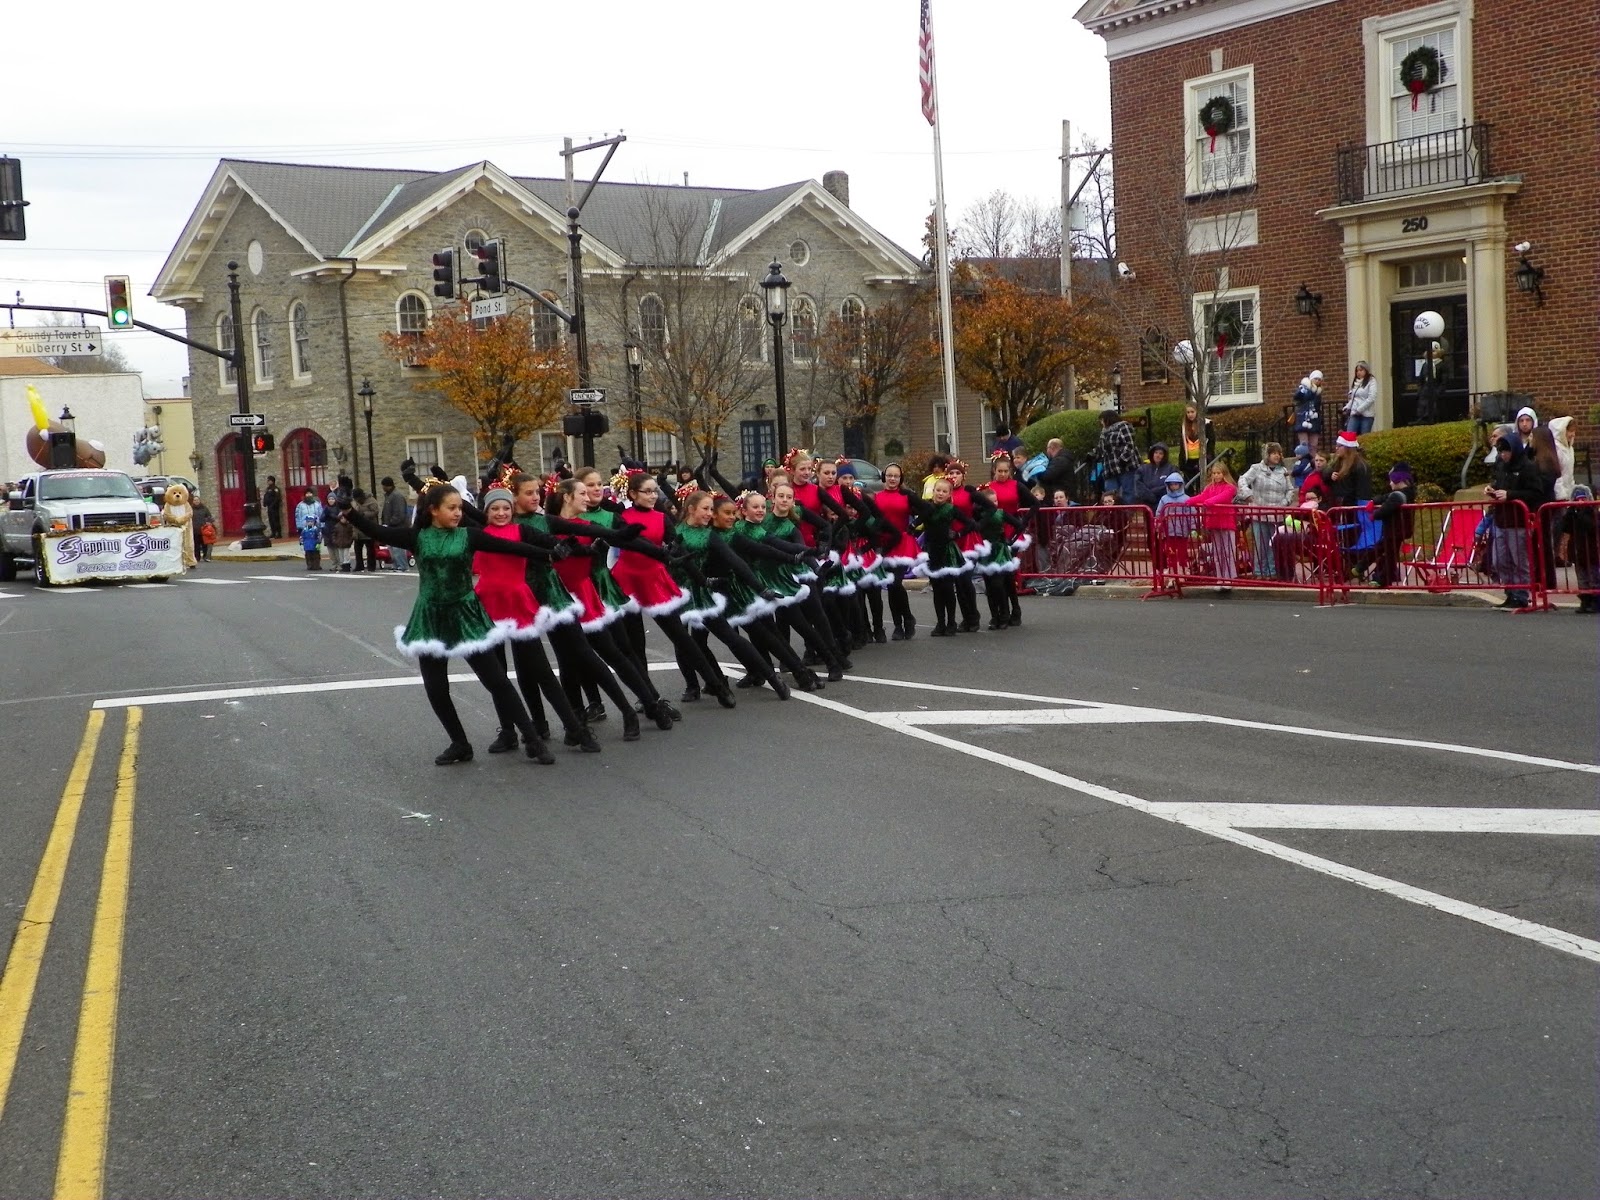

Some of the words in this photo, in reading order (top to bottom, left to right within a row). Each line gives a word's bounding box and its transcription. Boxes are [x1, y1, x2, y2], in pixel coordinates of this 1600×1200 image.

[1402, 216, 1428, 233] 250
[475, 303, 491, 315] Pond
[17, 330, 52, 342] Grundy
[54, 329, 80, 340] Tower
[84, 329, 95, 340] Dr
[16, 343, 67, 355] Mulberry
[71, 342, 82, 352] St
[57, 536, 121, 564] Stepping
[125, 532, 170, 558] Stone
[77, 561, 117, 573] Dance
[119, 559, 157, 572] Studio
